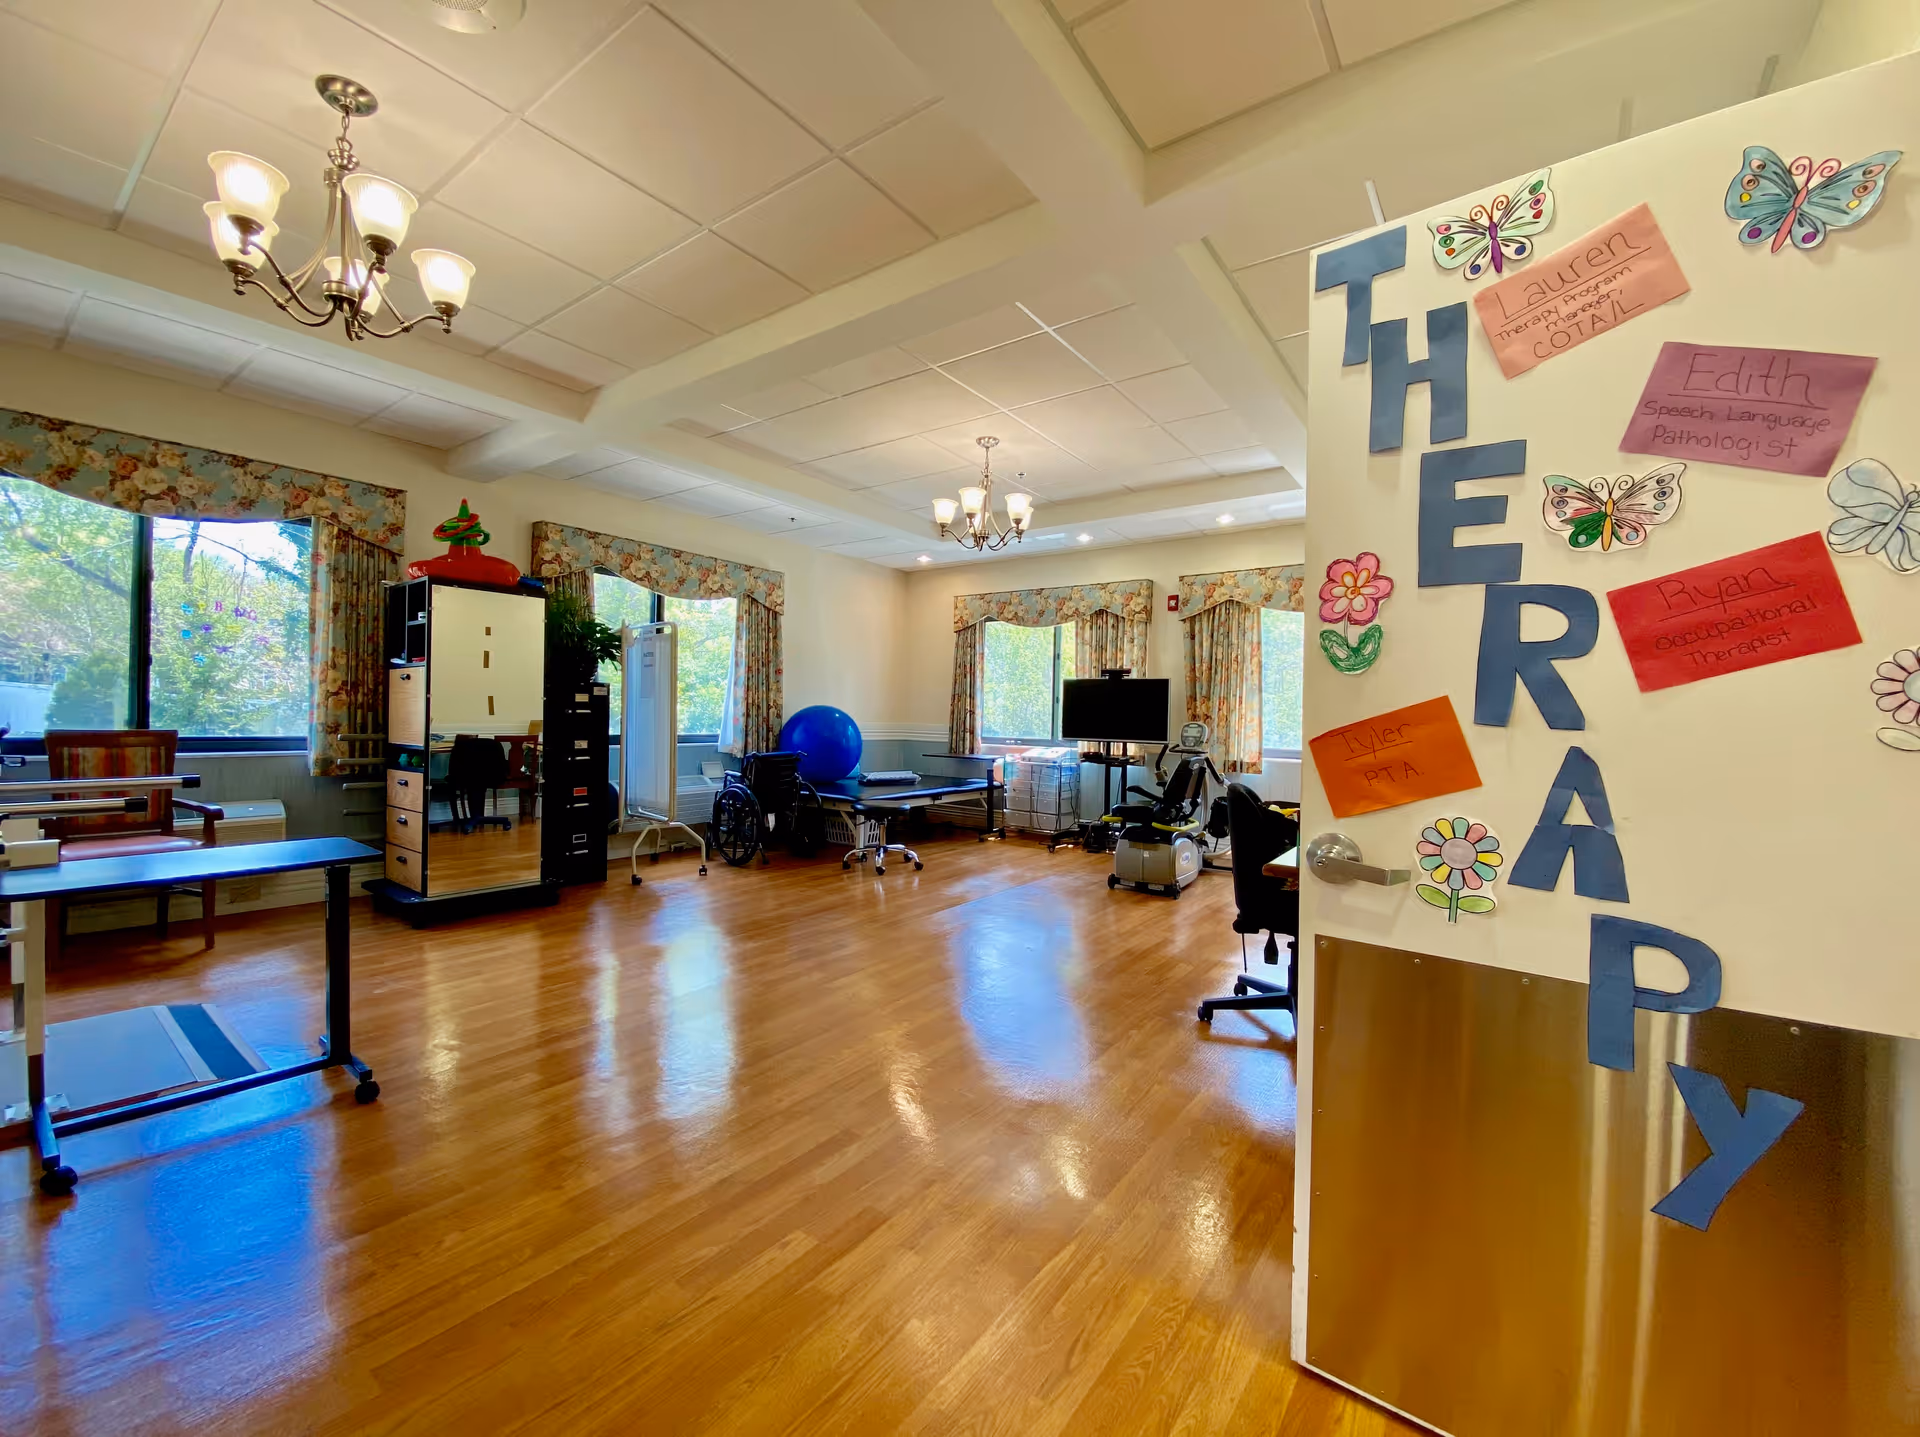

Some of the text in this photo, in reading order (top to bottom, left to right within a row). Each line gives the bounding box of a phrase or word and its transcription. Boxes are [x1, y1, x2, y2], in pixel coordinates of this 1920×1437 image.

[1496, 233, 1641, 319] Lauren
[1494, 306, 1560, 341] Therapy
[1534, 300, 1644, 359] COTA/L
[1682, 352, 1815, 405] Edith
[1641, 400, 1830, 436] Speech Language
[1652, 424, 1798, 460] Pathologist
[1656, 567, 1788, 614] Ryan
[1684, 627, 1791, 666] Therapist
[1315, 226, 1804, 1231] THERAPY
[1330, 724, 1410, 760] Tyler
